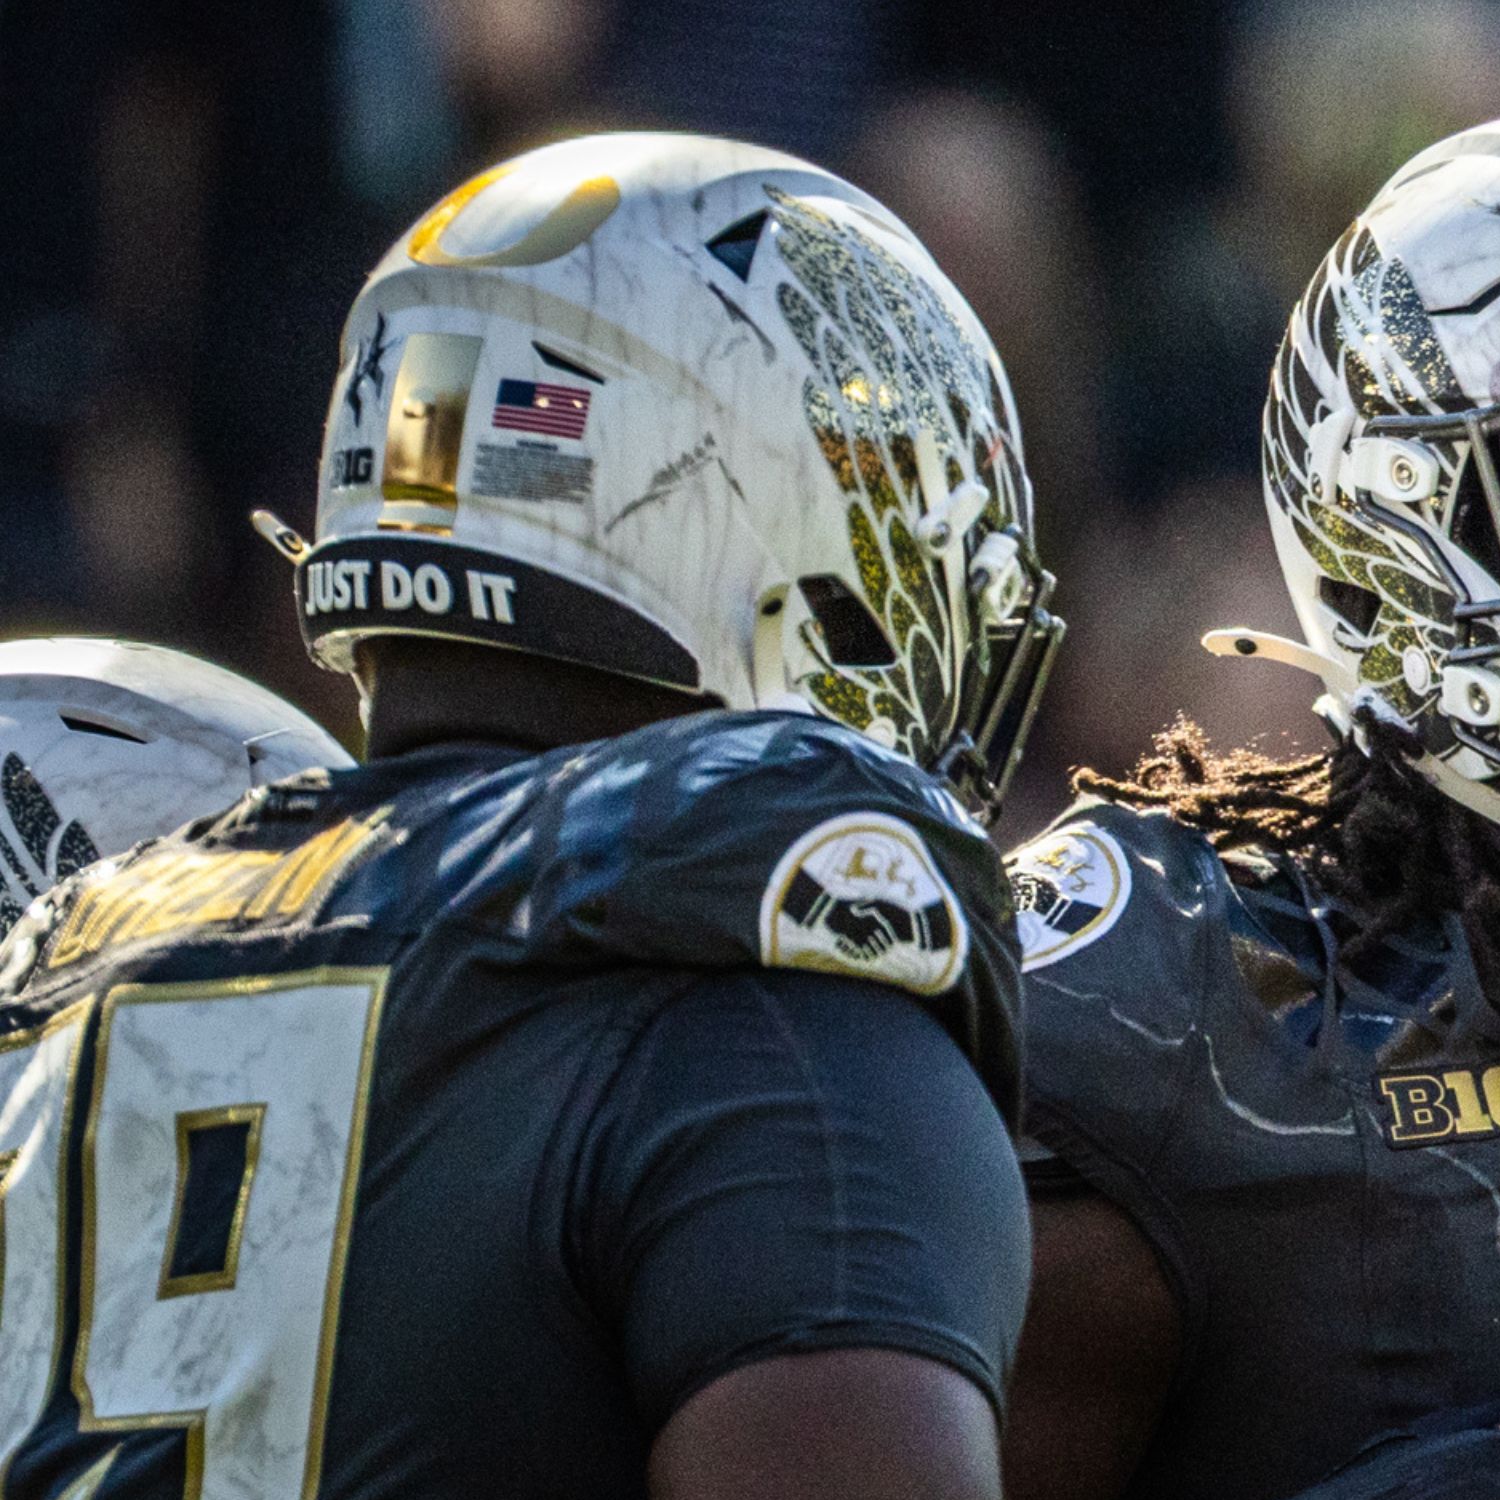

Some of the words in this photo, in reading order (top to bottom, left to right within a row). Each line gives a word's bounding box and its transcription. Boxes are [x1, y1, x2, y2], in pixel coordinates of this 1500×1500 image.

[305, 558, 373, 617] JUST
[380, 560, 454, 616] DO
[466, 569, 517, 625] IT
